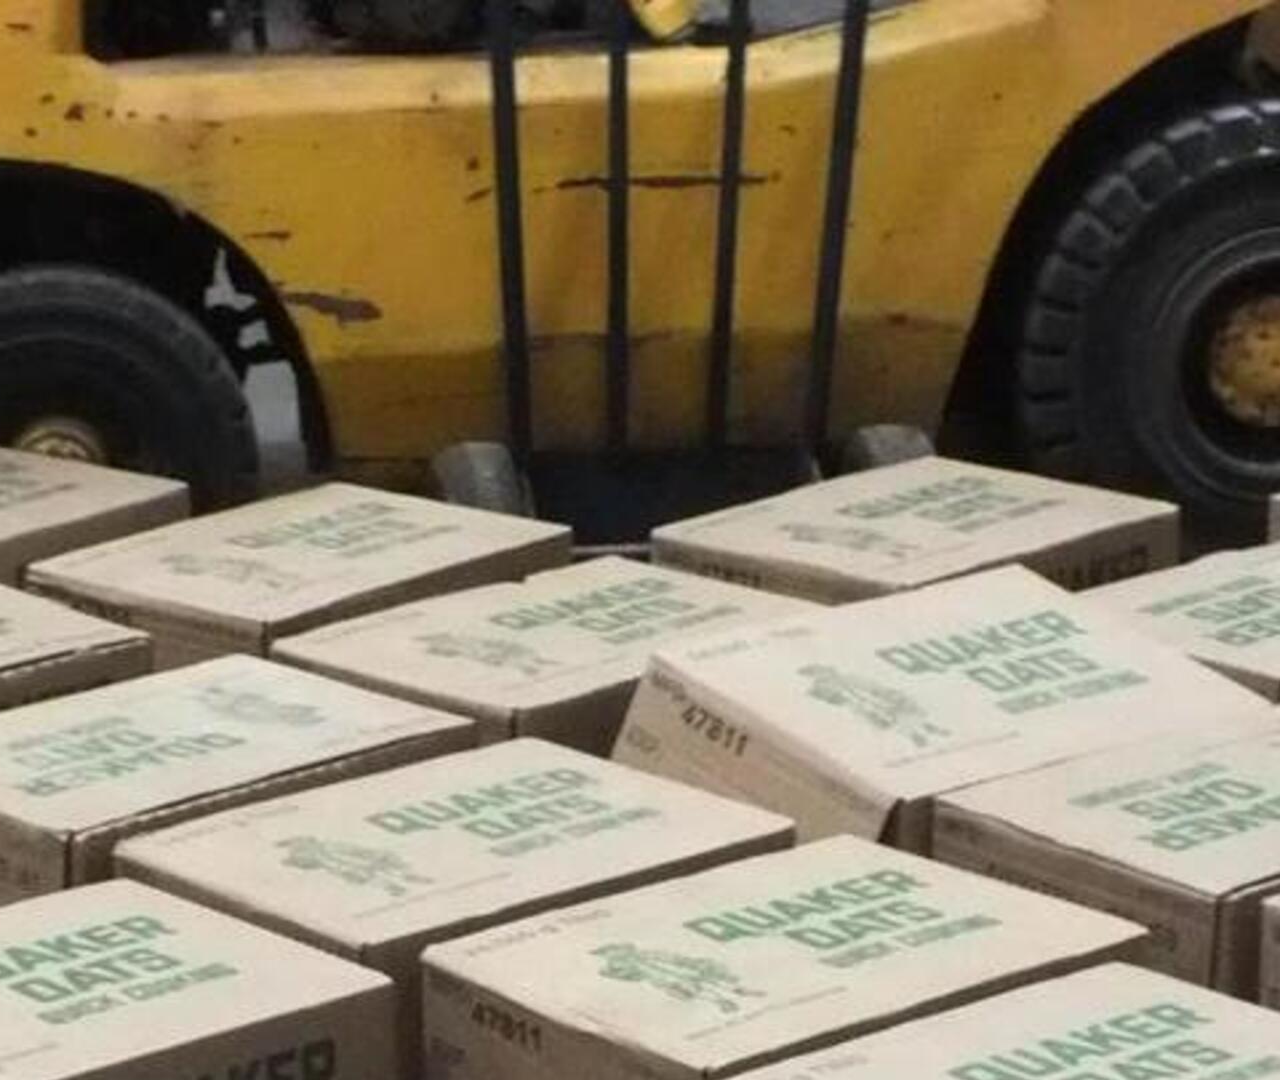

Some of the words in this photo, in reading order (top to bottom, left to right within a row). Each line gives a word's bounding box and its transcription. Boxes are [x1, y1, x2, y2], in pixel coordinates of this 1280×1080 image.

[875, 609, 1090, 675] QUAKER
[963, 649, 1104, 695] OATS
[684, 869, 924, 943] QUAKER
[782, 902, 944, 952] OATS
[9, 946, 184, 1004] OATS
